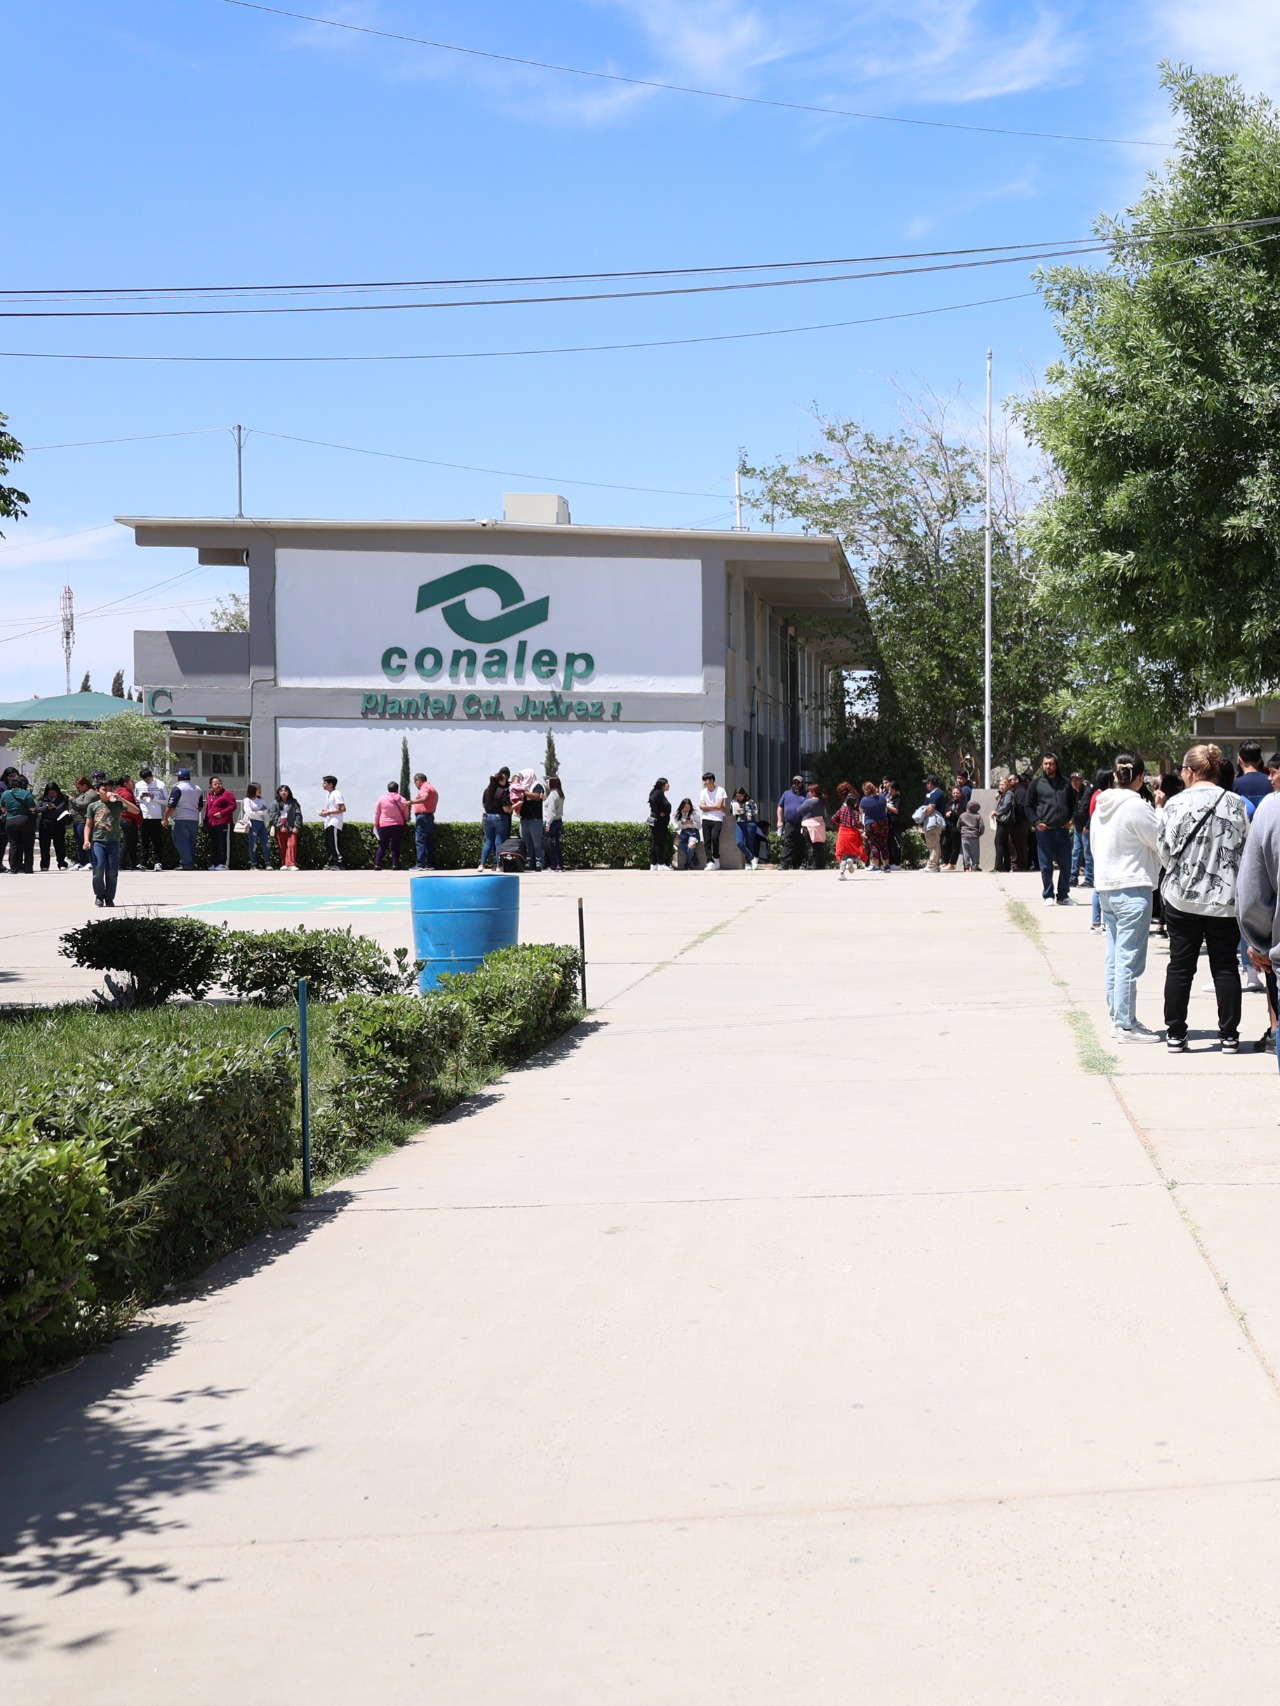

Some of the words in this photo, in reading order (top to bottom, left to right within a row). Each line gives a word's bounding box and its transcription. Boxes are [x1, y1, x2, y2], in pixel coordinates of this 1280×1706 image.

[381, 640, 595, 690] conalep
[148, 687, 173, 716] C
[361, 692, 455, 715] Plantel
[462, 693, 503, 716] Cd.
[514, 693, 604, 717] Juárez
